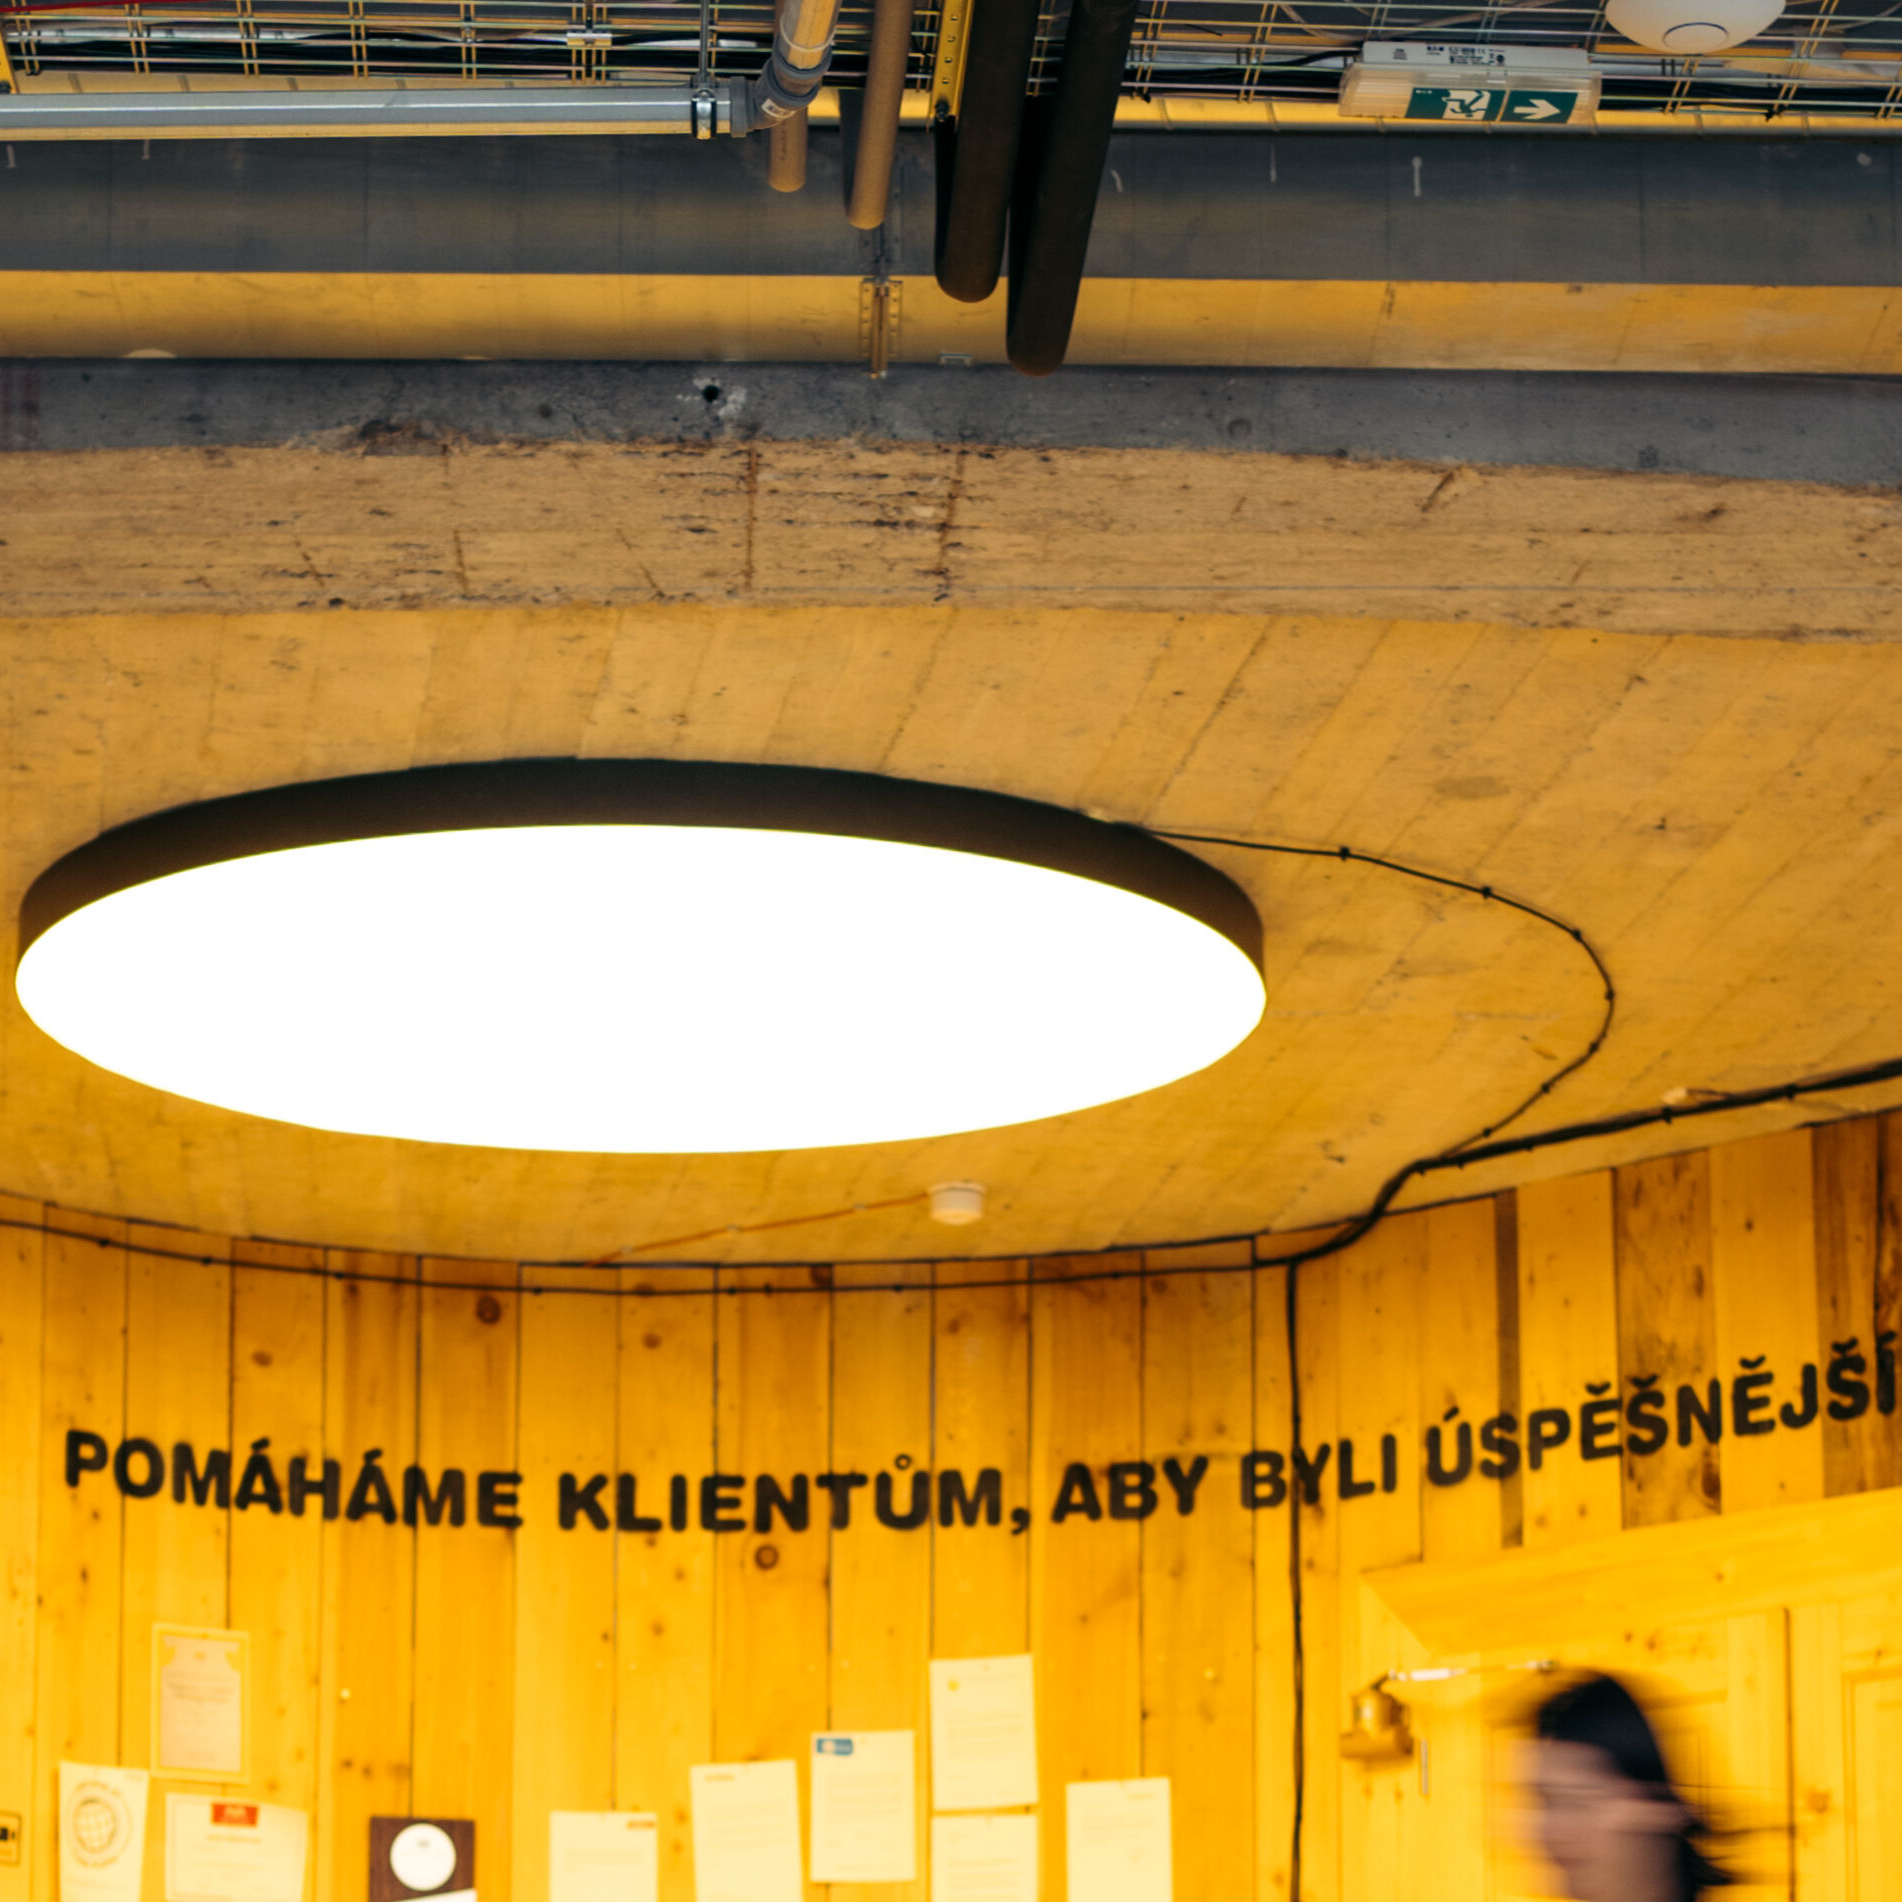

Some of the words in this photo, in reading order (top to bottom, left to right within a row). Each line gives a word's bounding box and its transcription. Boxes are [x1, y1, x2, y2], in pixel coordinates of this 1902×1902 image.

[65, 1429, 524, 1530] POMÁHÁME
[558, 1453, 1031, 1536] KLIENTŮM,
[1051, 1455, 1210, 1523] ABY
[1240, 1433, 1397, 1509] BYLI
[1426, 1331, 1899, 1488] ÚSPĚŠNĚJŠÍ
